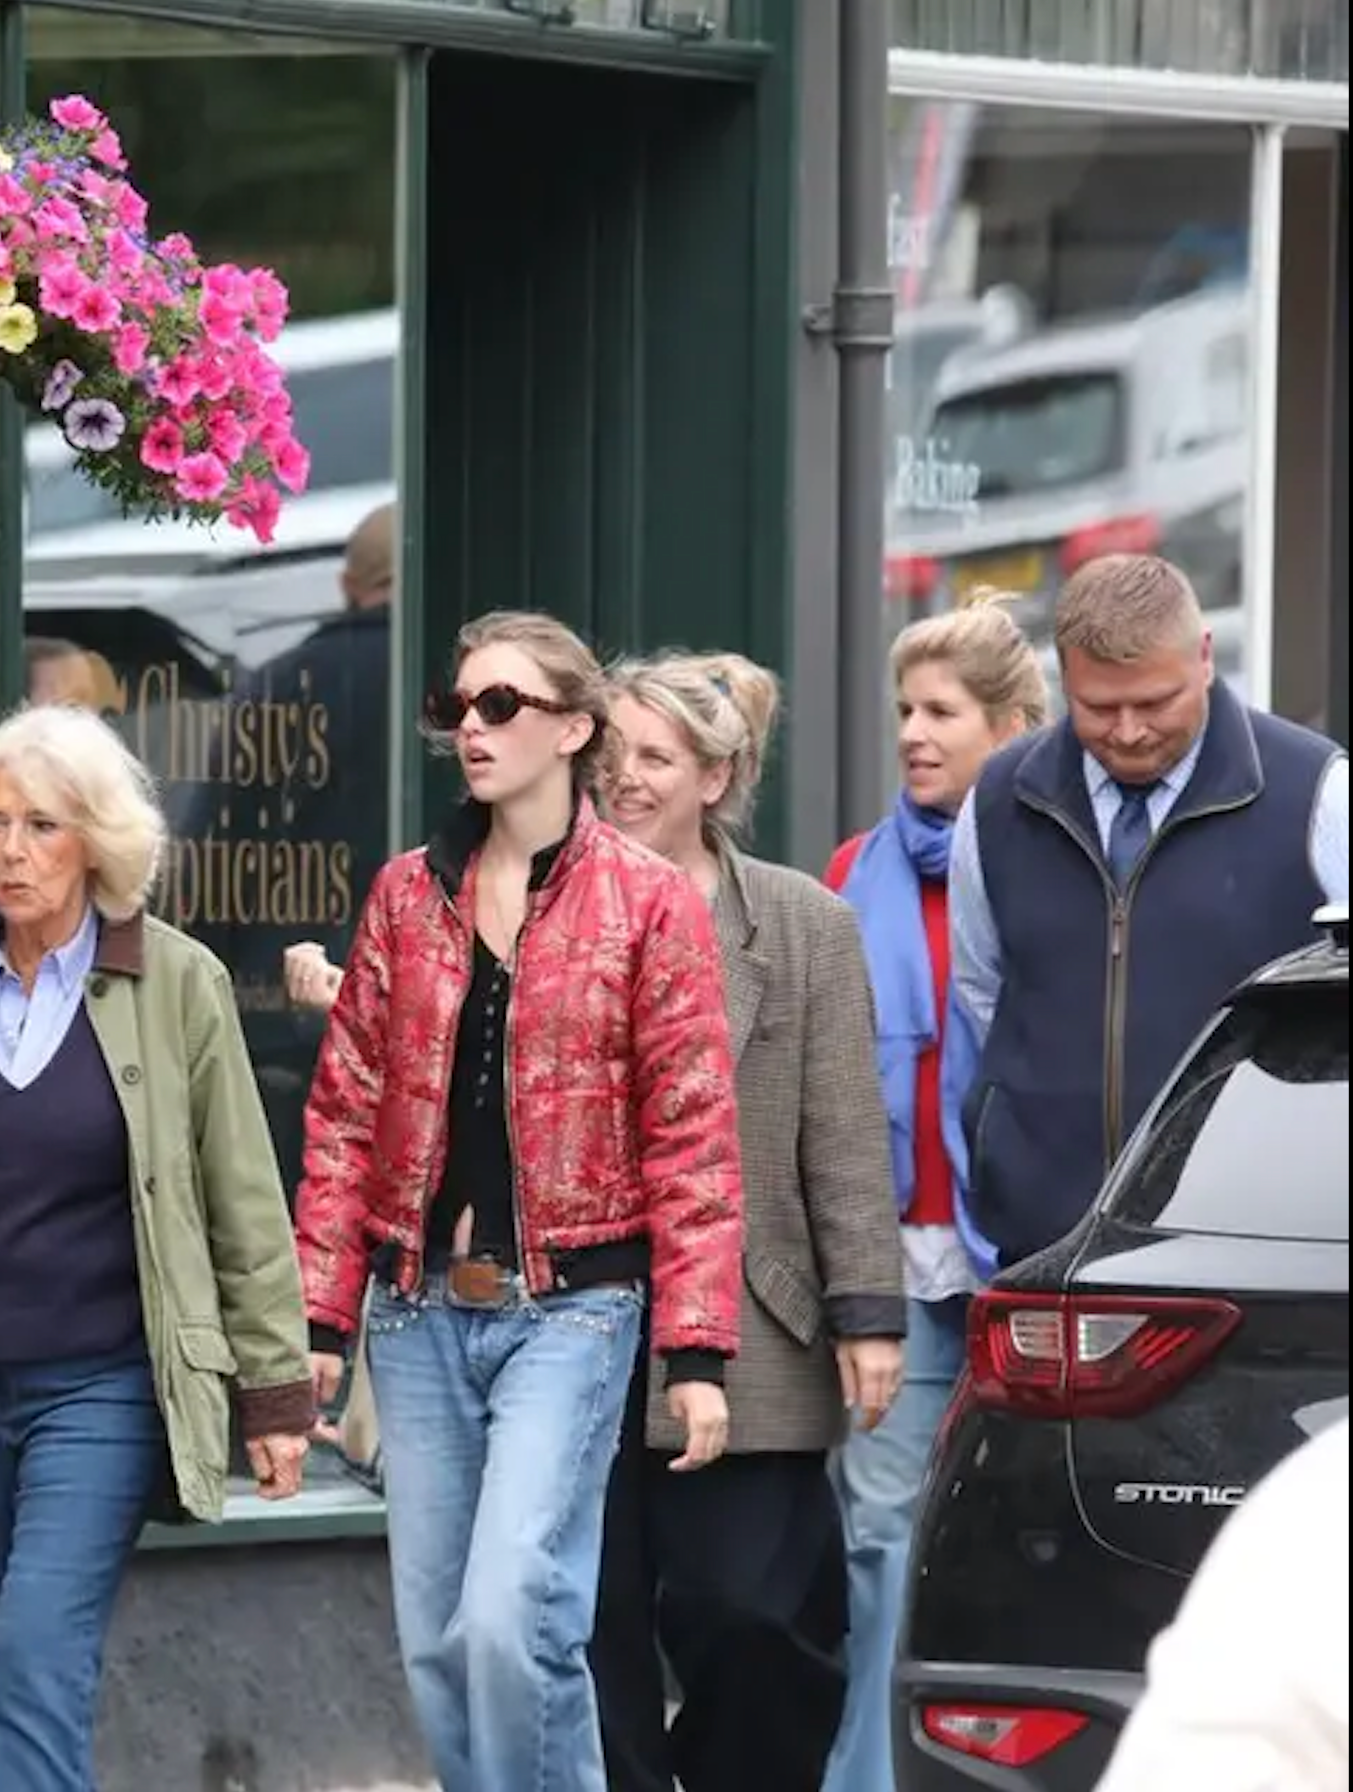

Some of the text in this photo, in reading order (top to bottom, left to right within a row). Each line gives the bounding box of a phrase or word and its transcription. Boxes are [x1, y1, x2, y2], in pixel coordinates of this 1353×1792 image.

[896, 434, 981, 517] Baking
[136, 660, 331, 823] Christy's
[1114, 1482, 1247, 1506] STONIC
